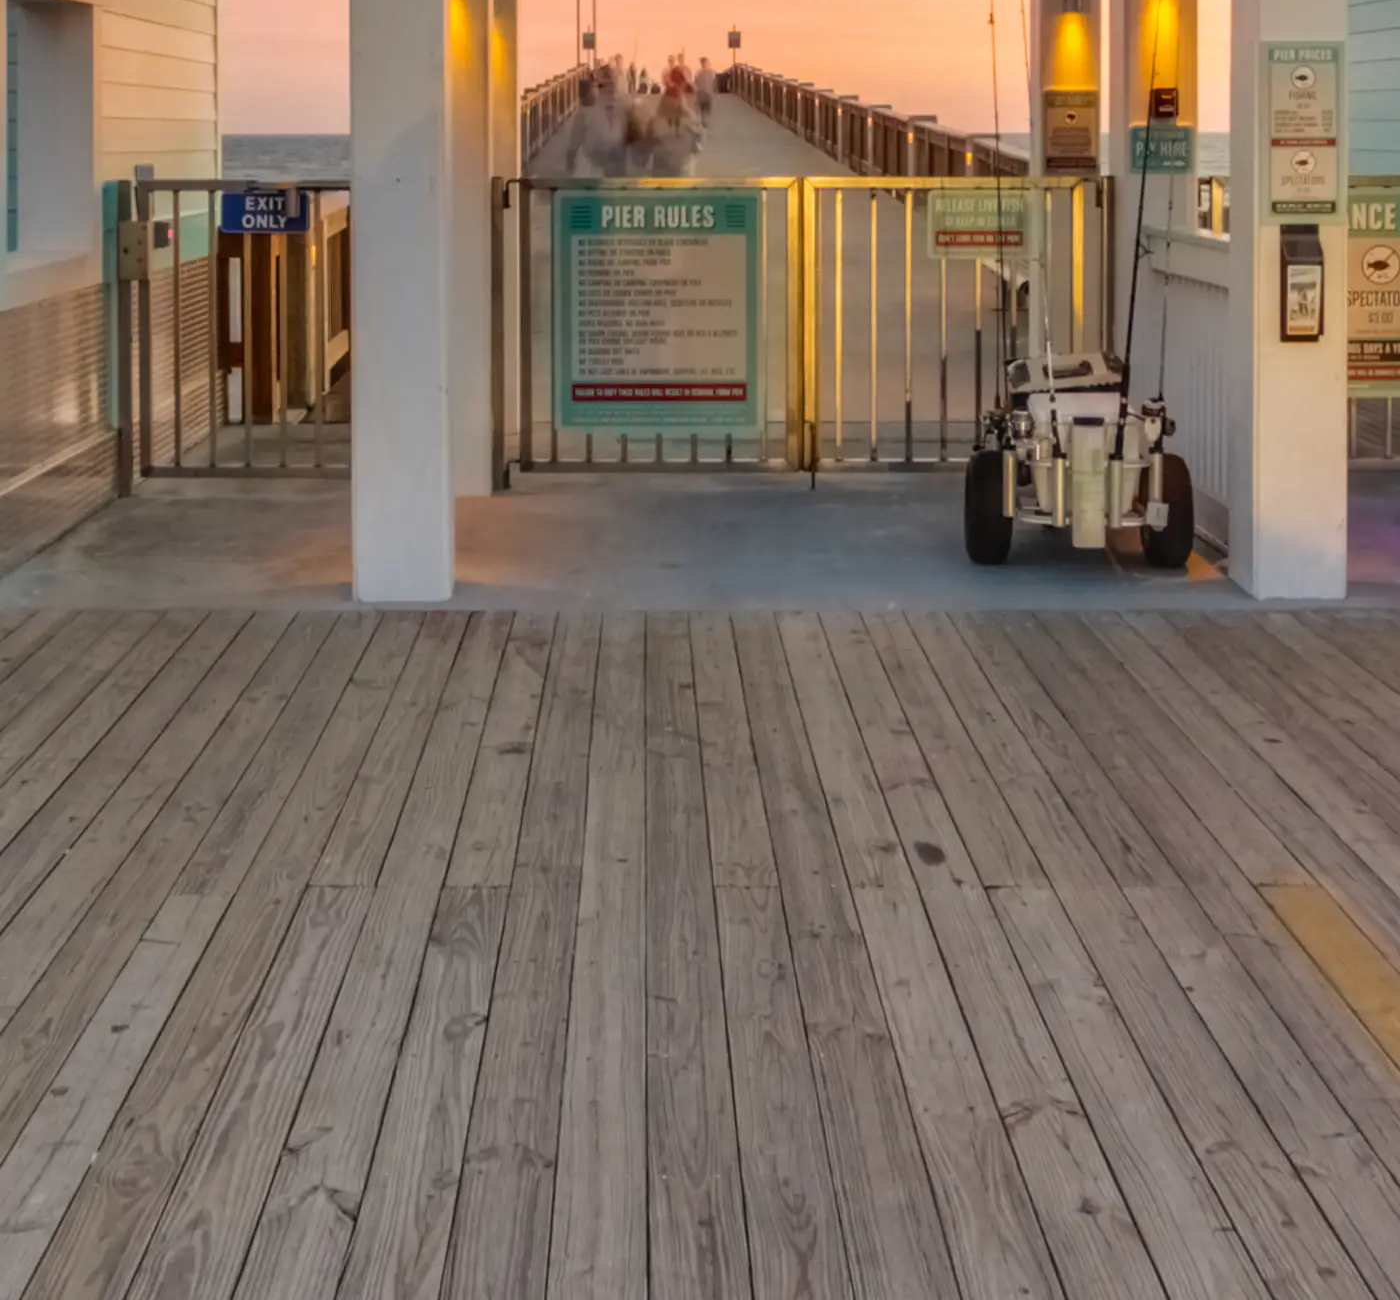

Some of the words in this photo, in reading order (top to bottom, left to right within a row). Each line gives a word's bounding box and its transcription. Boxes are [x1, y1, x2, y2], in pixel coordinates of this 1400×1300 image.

[1274, 49, 1295, 61] PIER
[1299, 49, 1332, 61] PRICES
[1136, 142, 1156, 157] PY
[1160, 141, 1188, 157] HERE
[245, 197, 284, 211] EXIT
[935, 199, 975, 213] RELEASE
[241, 214, 287, 229] ONLY
[601, 205, 646, 229] PIER
[654, 205, 715, 229] RULES
